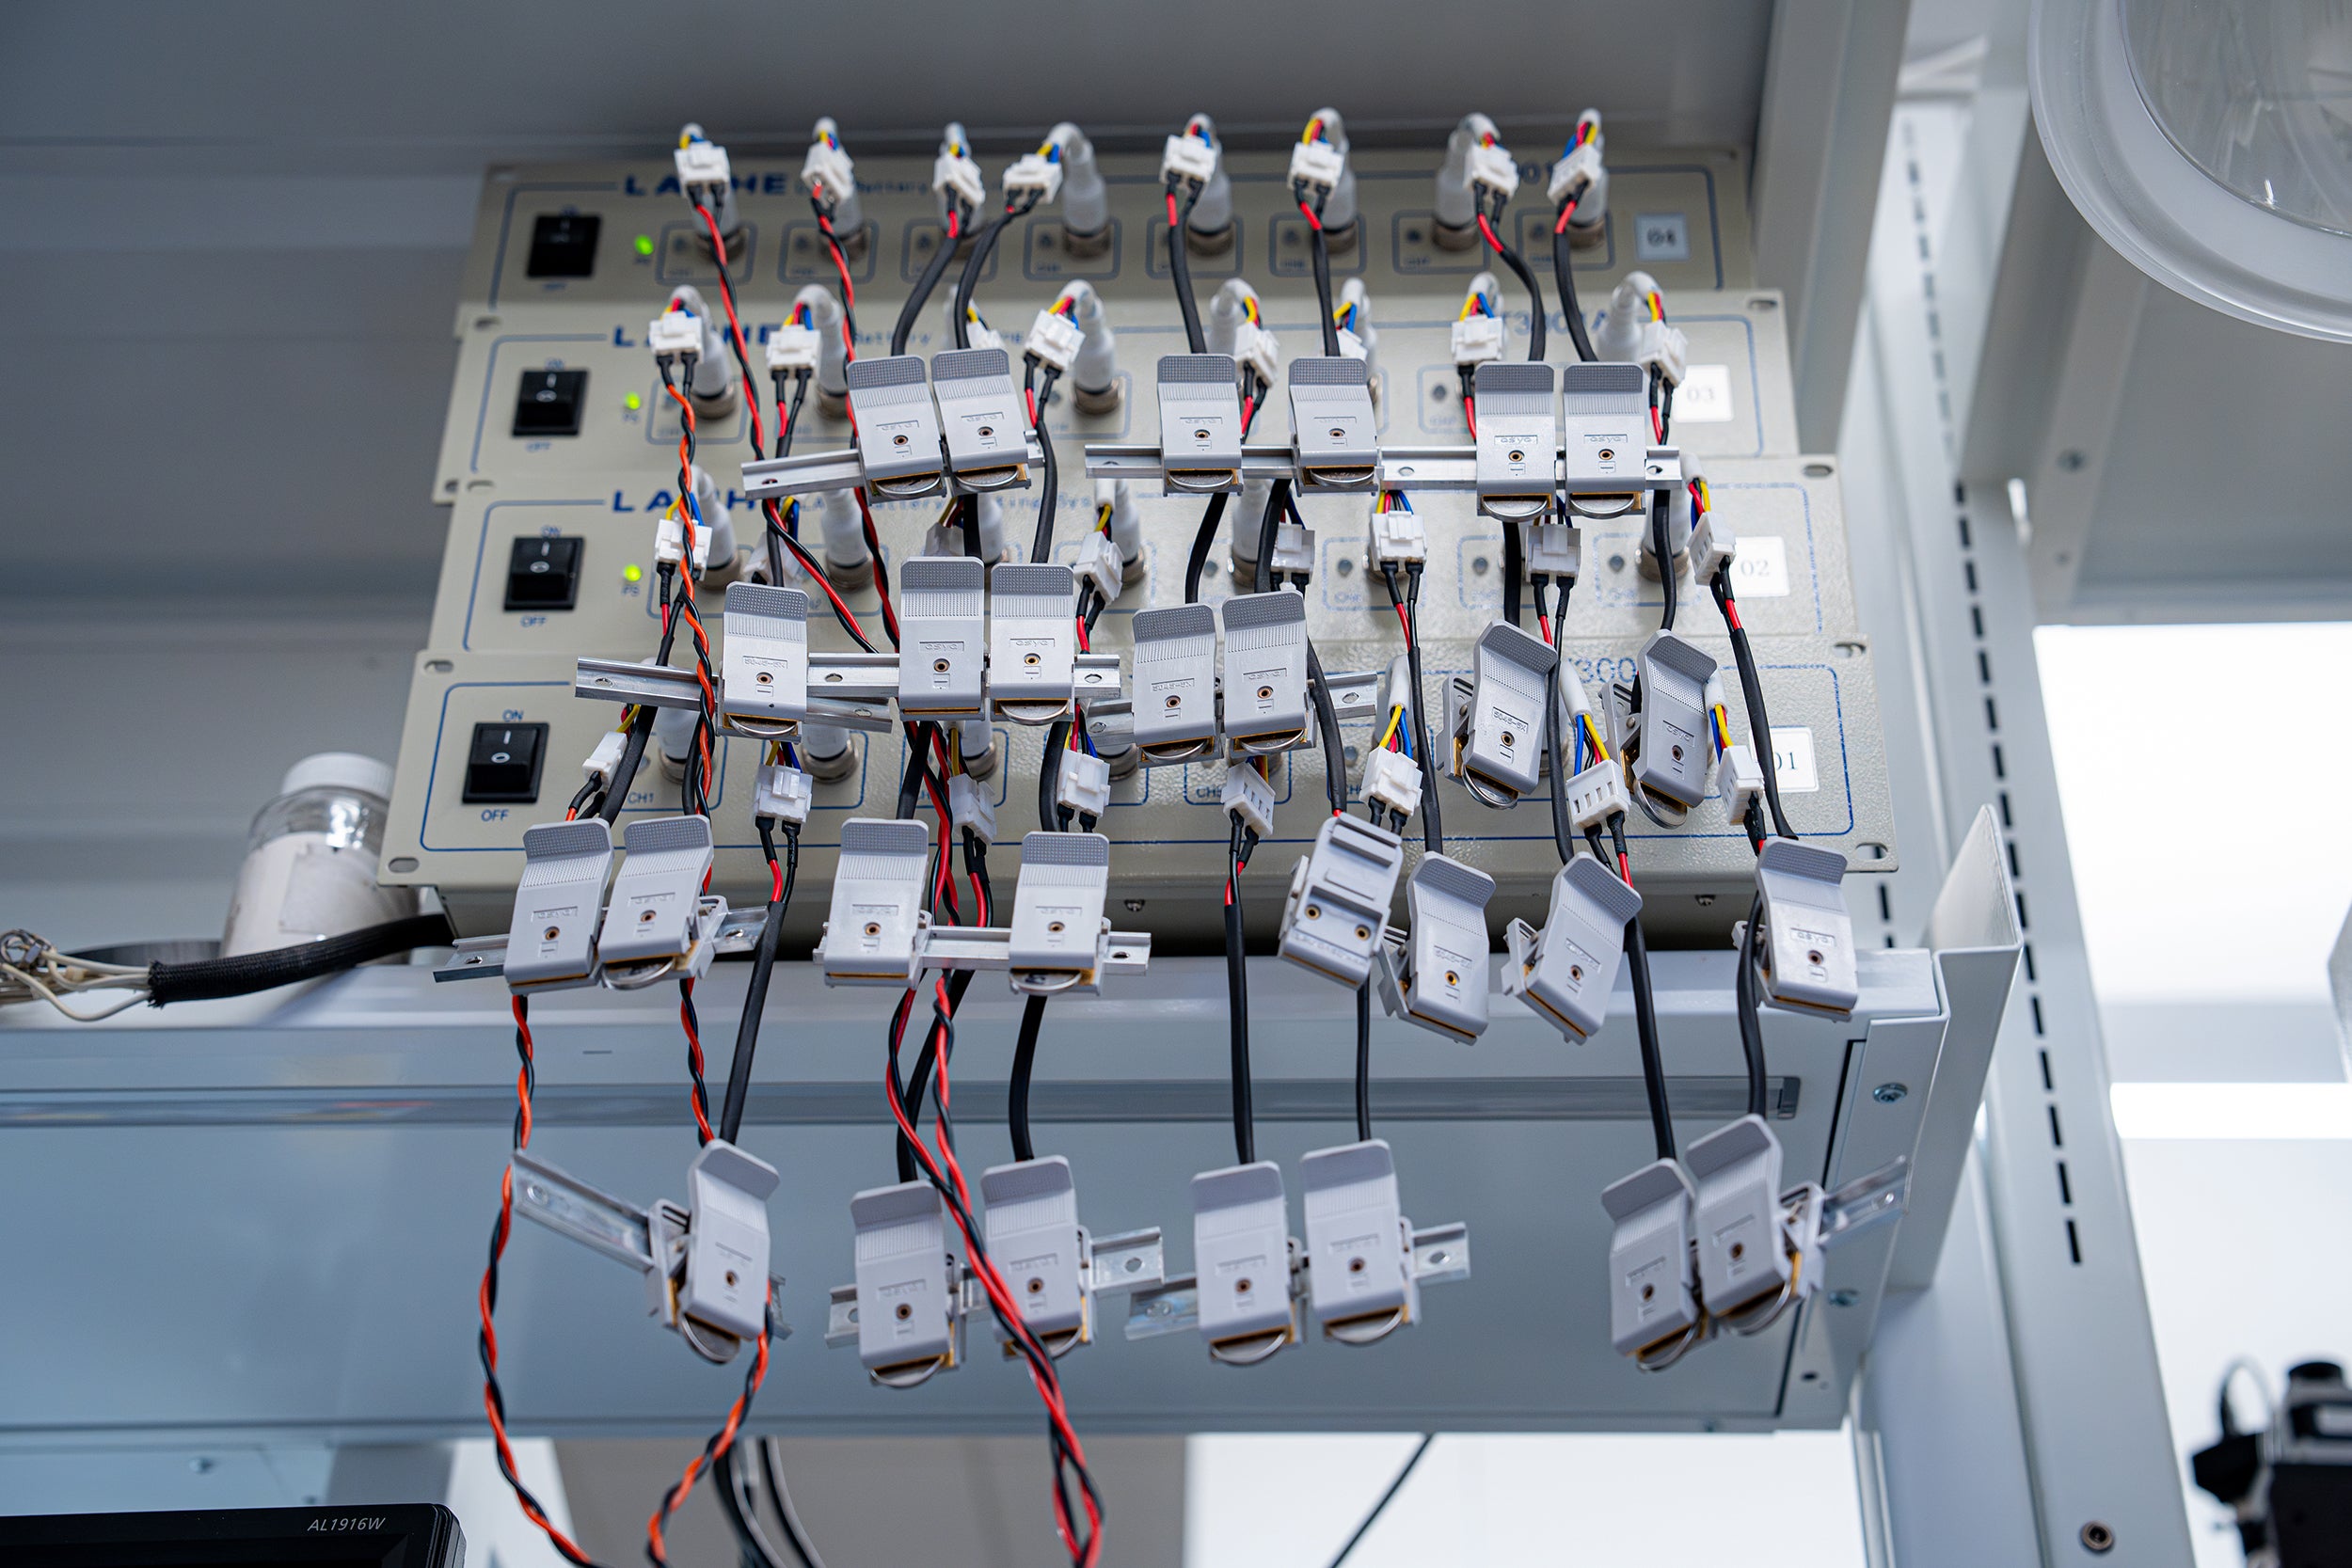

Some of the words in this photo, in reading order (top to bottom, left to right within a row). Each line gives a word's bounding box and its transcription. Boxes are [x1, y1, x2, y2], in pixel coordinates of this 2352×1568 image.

[625, 173, 787, 197] LAHE
[1687, 384, 1715, 403] 03
[1740, 560, 1771, 577] 02
[501, 708, 525, 722] ON
[1492, 710, 1527, 732] 5045-5X
[628, 792, 655, 804] CH1
[481, 808, 510, 822] OFF
[307, 1517, 387, 1531] AL1916W
